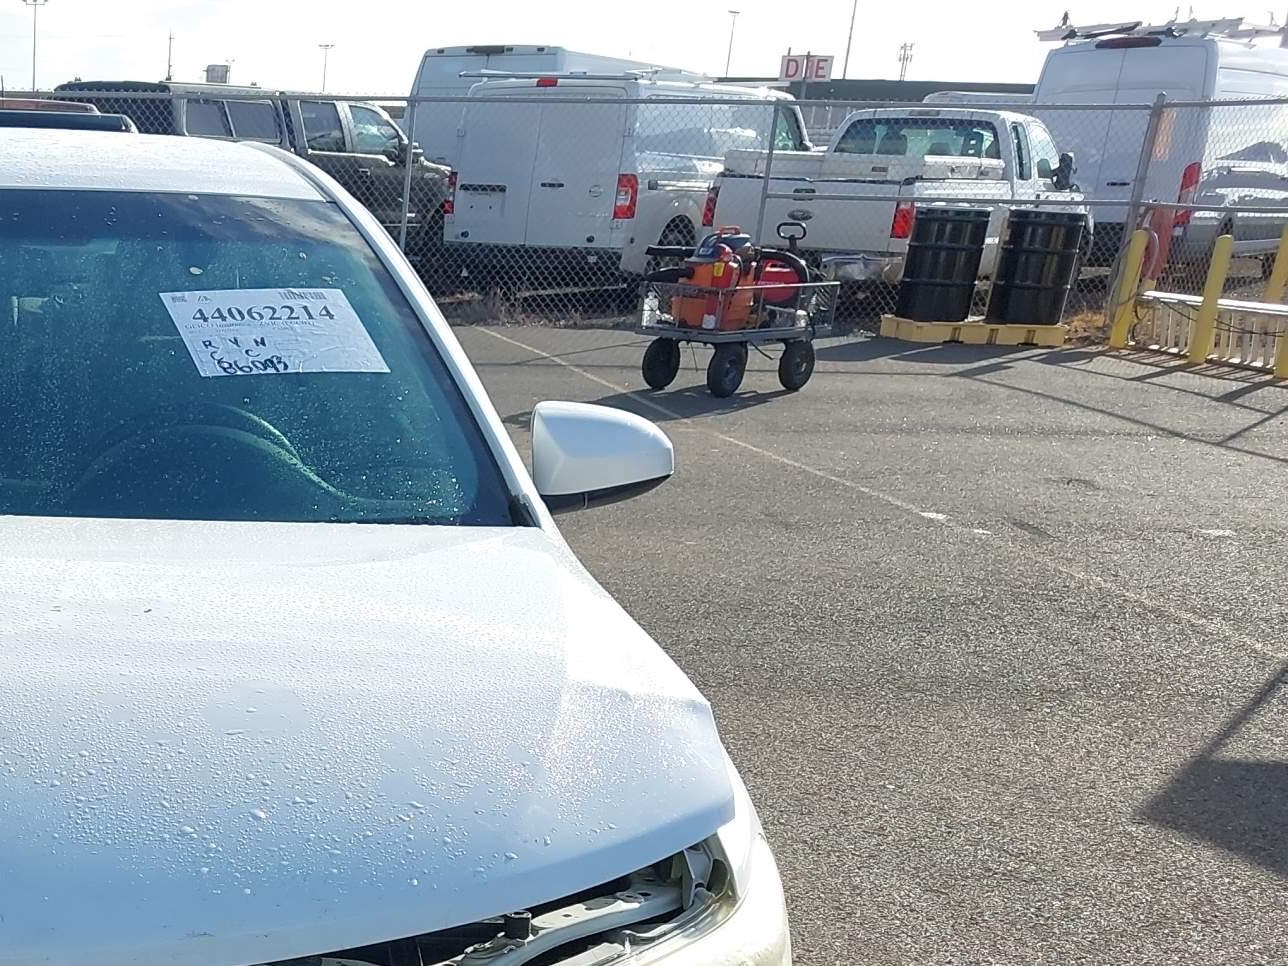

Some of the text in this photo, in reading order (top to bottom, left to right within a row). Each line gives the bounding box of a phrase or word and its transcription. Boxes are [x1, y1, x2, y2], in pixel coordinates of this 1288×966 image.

[784, 58, 829, 78] D E
[192, 304, 336, 323] 44062214
